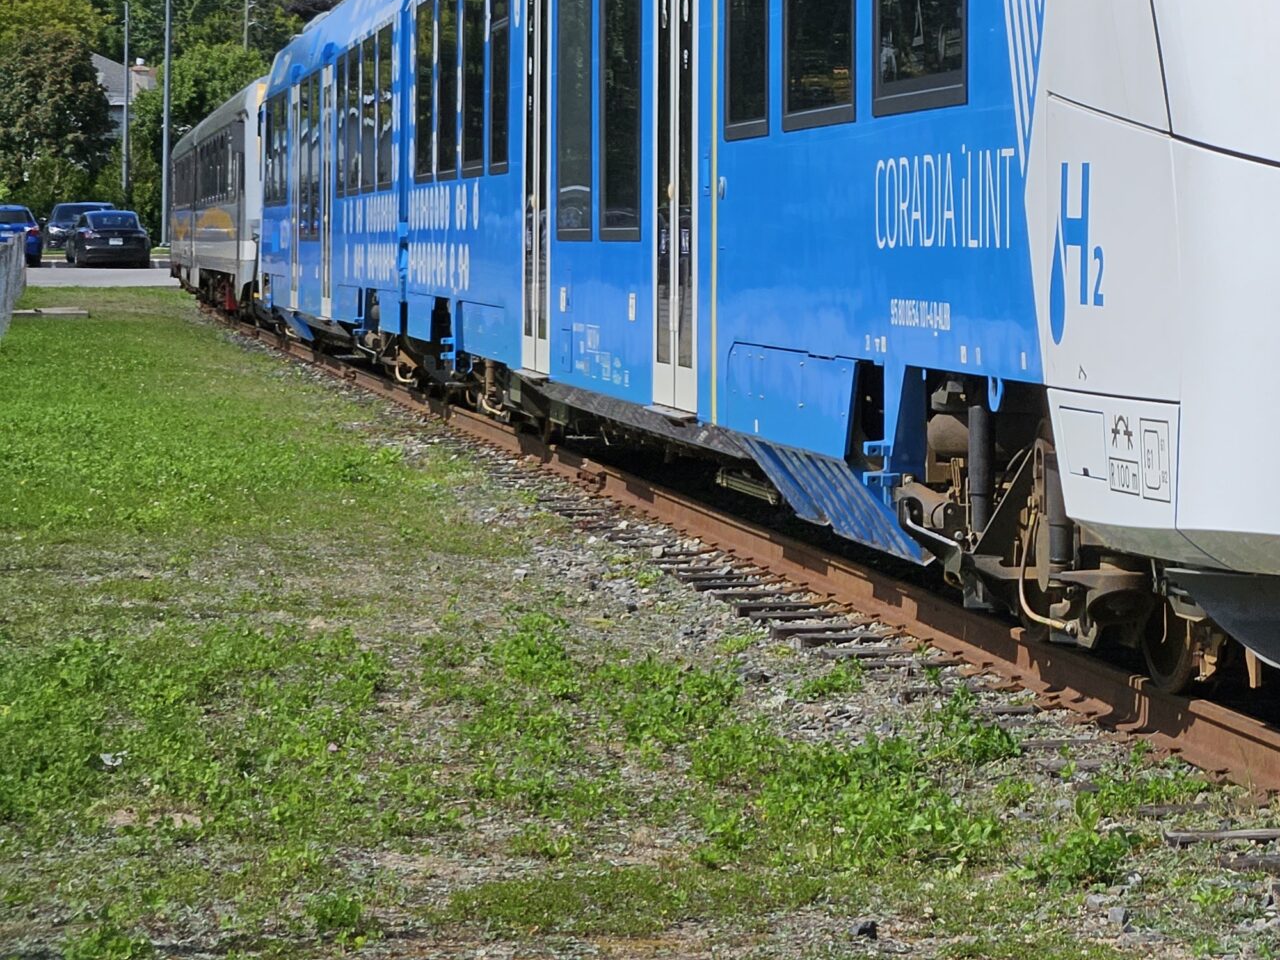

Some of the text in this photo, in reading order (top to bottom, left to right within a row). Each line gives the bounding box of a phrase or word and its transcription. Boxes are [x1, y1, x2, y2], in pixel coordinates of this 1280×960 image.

[876, 144, 1015, 249] CORADIA iLINT
[1117, 464, 1130, 488] 100
